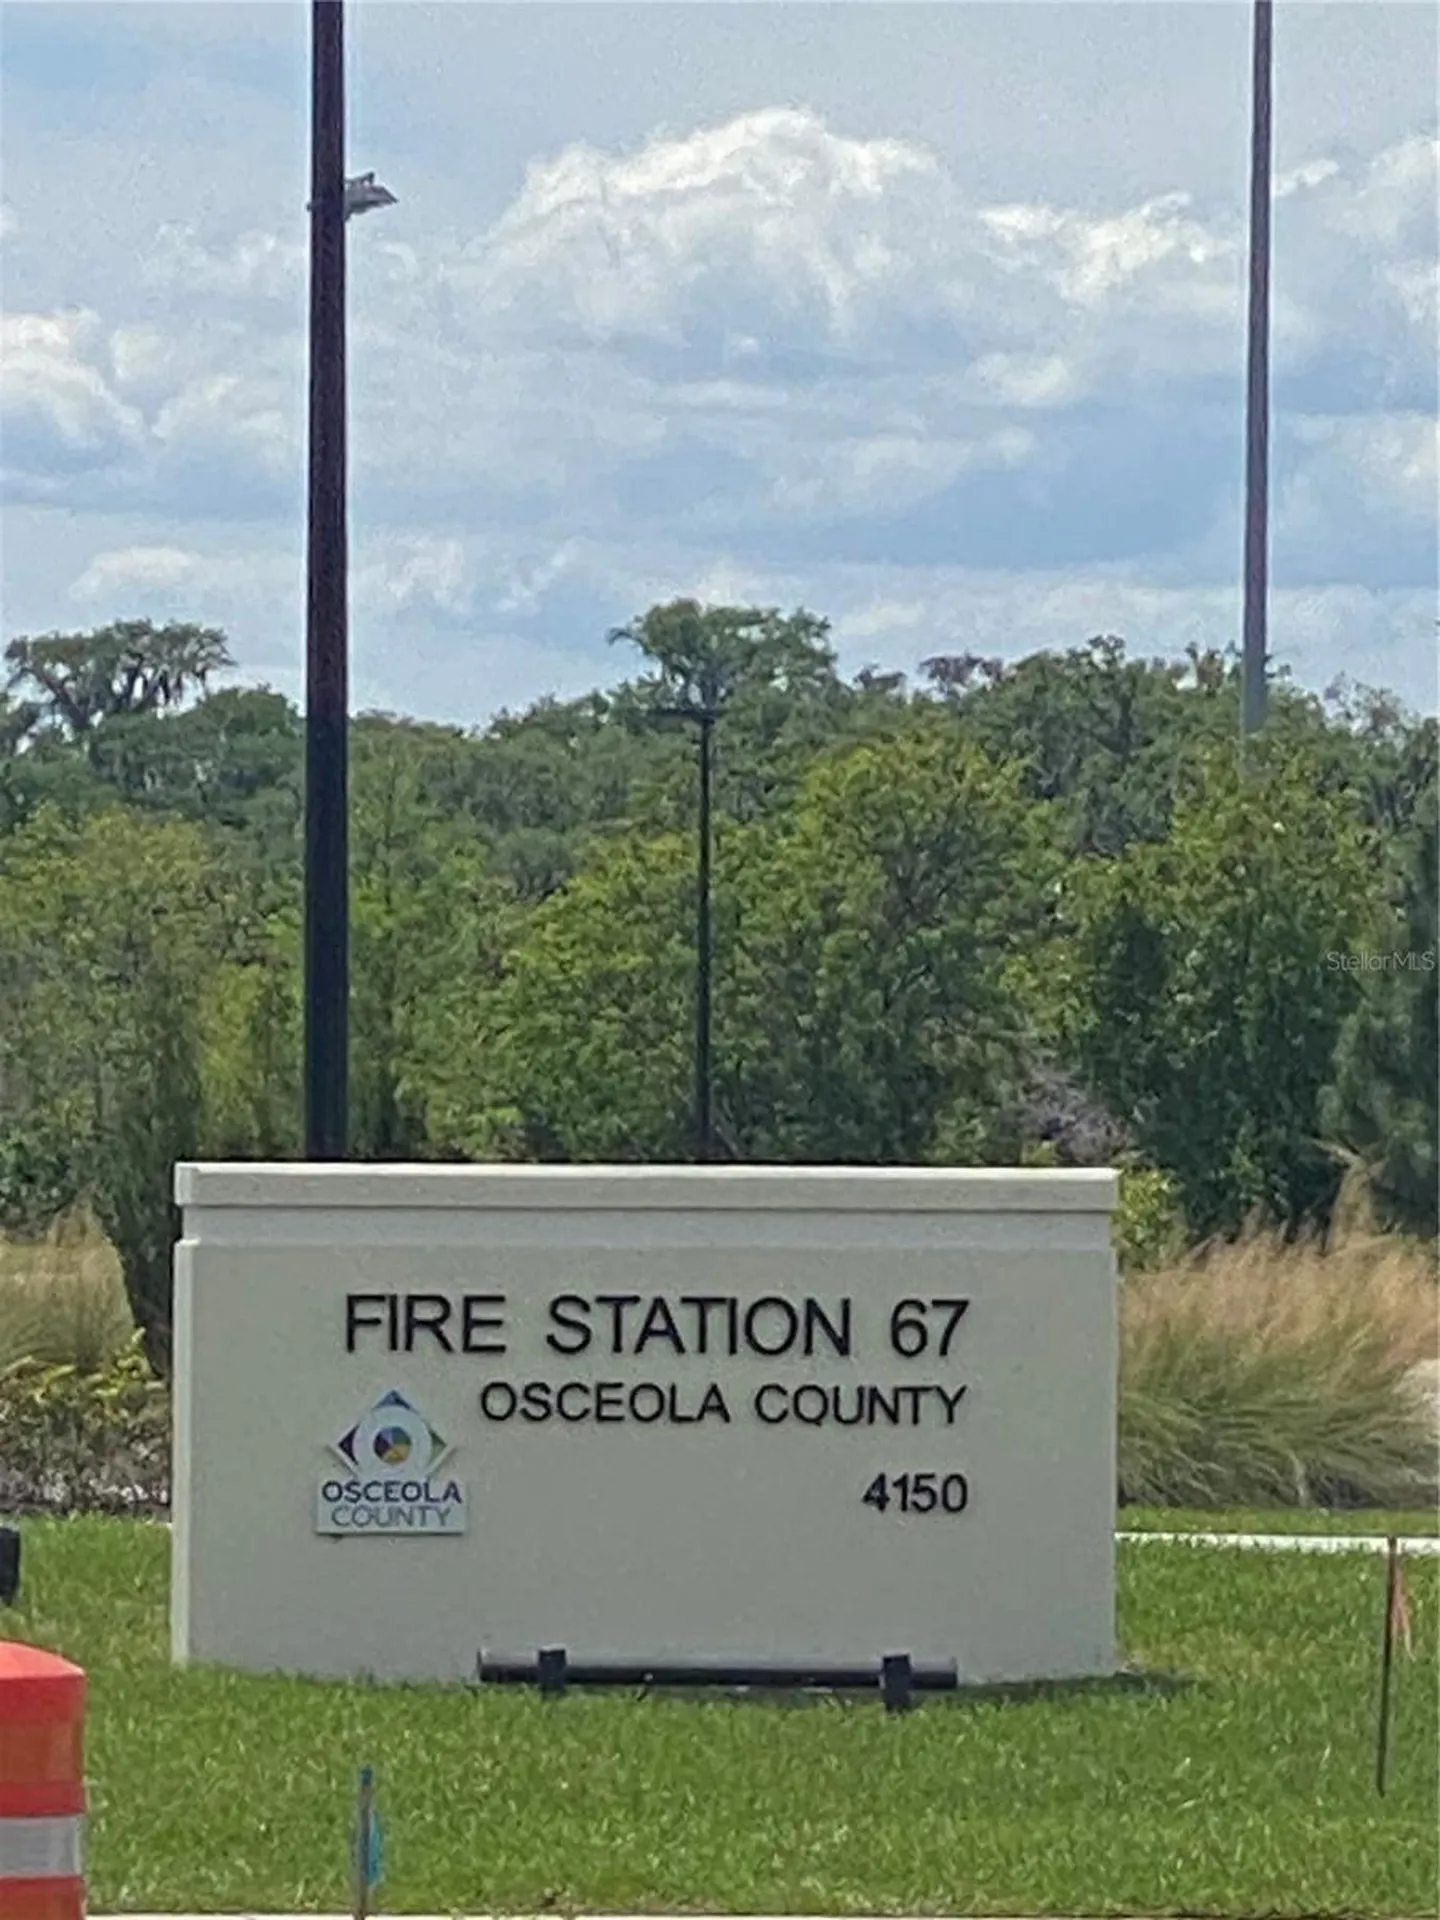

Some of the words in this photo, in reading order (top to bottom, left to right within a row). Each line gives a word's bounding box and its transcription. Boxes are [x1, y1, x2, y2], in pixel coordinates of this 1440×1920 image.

[345, 1294, 507, 1355] FIRE
[545, 1295, 851, 1358] STATION
[890, 1299, 970, 1357] 67
[480, 1382, 730, 1424] OSCEOLA
[755, 1384, 967, 1427] COUNTY
[322, 1480, 462, 1504] OSCEOLA
[862, 1473, 968, 1514] 4150
[331, 1504, 451, 1528] COUNTY
